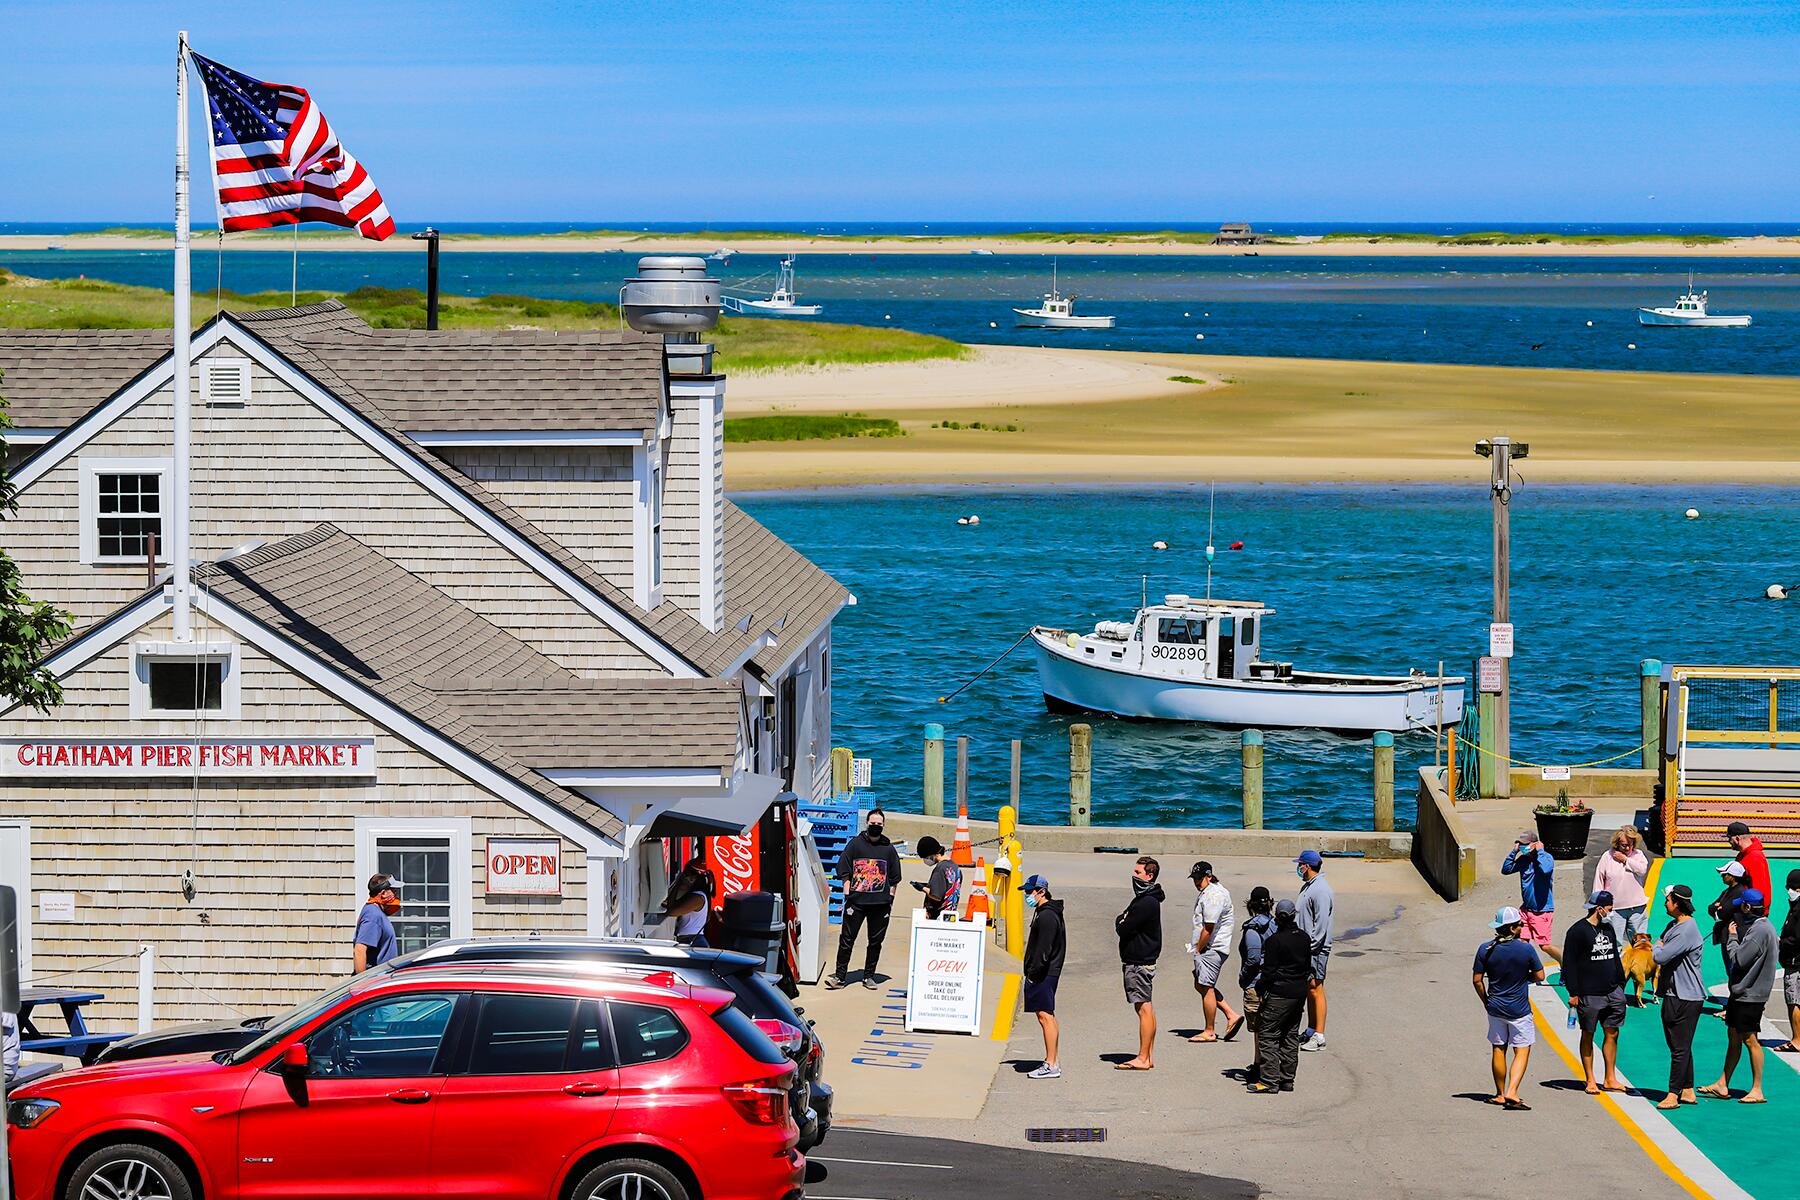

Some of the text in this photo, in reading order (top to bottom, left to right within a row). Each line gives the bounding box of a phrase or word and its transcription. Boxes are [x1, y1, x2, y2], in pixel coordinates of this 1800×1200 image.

[1151, 645, 1206, 661] 902890
[17, 743, 361, 767] CHATHAM PIER FISH MARKET
[492, 854, 557, 875] OPEN
[927, 959, 968, 973] OPEN!
